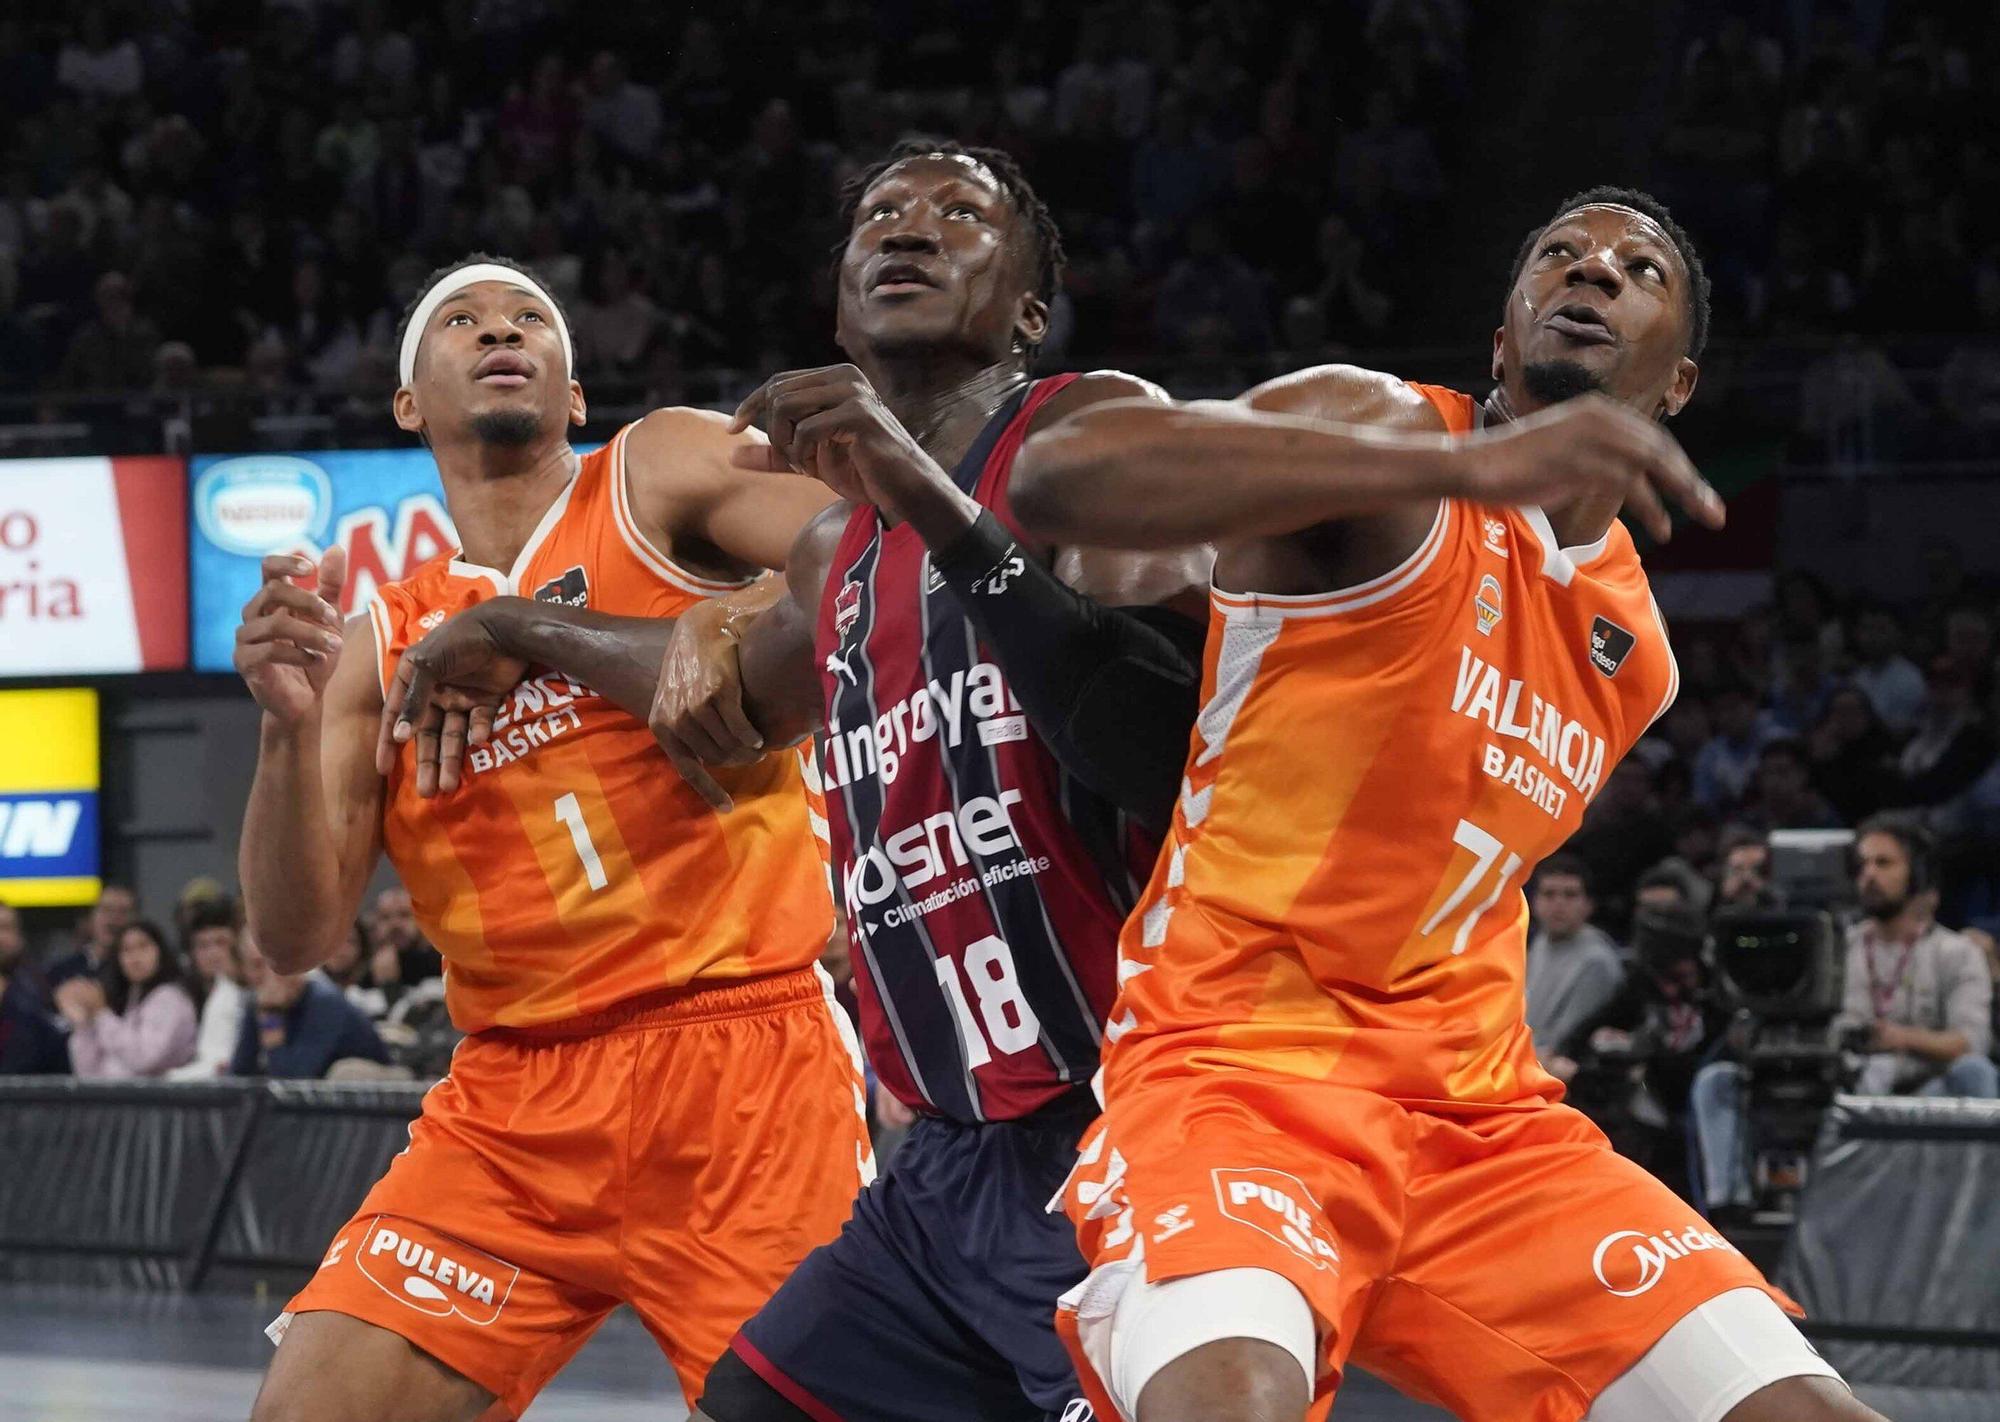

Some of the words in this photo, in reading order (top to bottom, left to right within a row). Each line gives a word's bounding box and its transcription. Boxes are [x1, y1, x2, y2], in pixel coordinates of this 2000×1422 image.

[470, 704, 582, 773] BASKET
[1451, 645, 1606, 804] VALENCIA
[1482, 743, 1568, 820] BASKET
[554, 791, 608, 892] 1
[935, 934, 1041, 1070] 18
[369, 1229, 495, 1305] PULEVA
